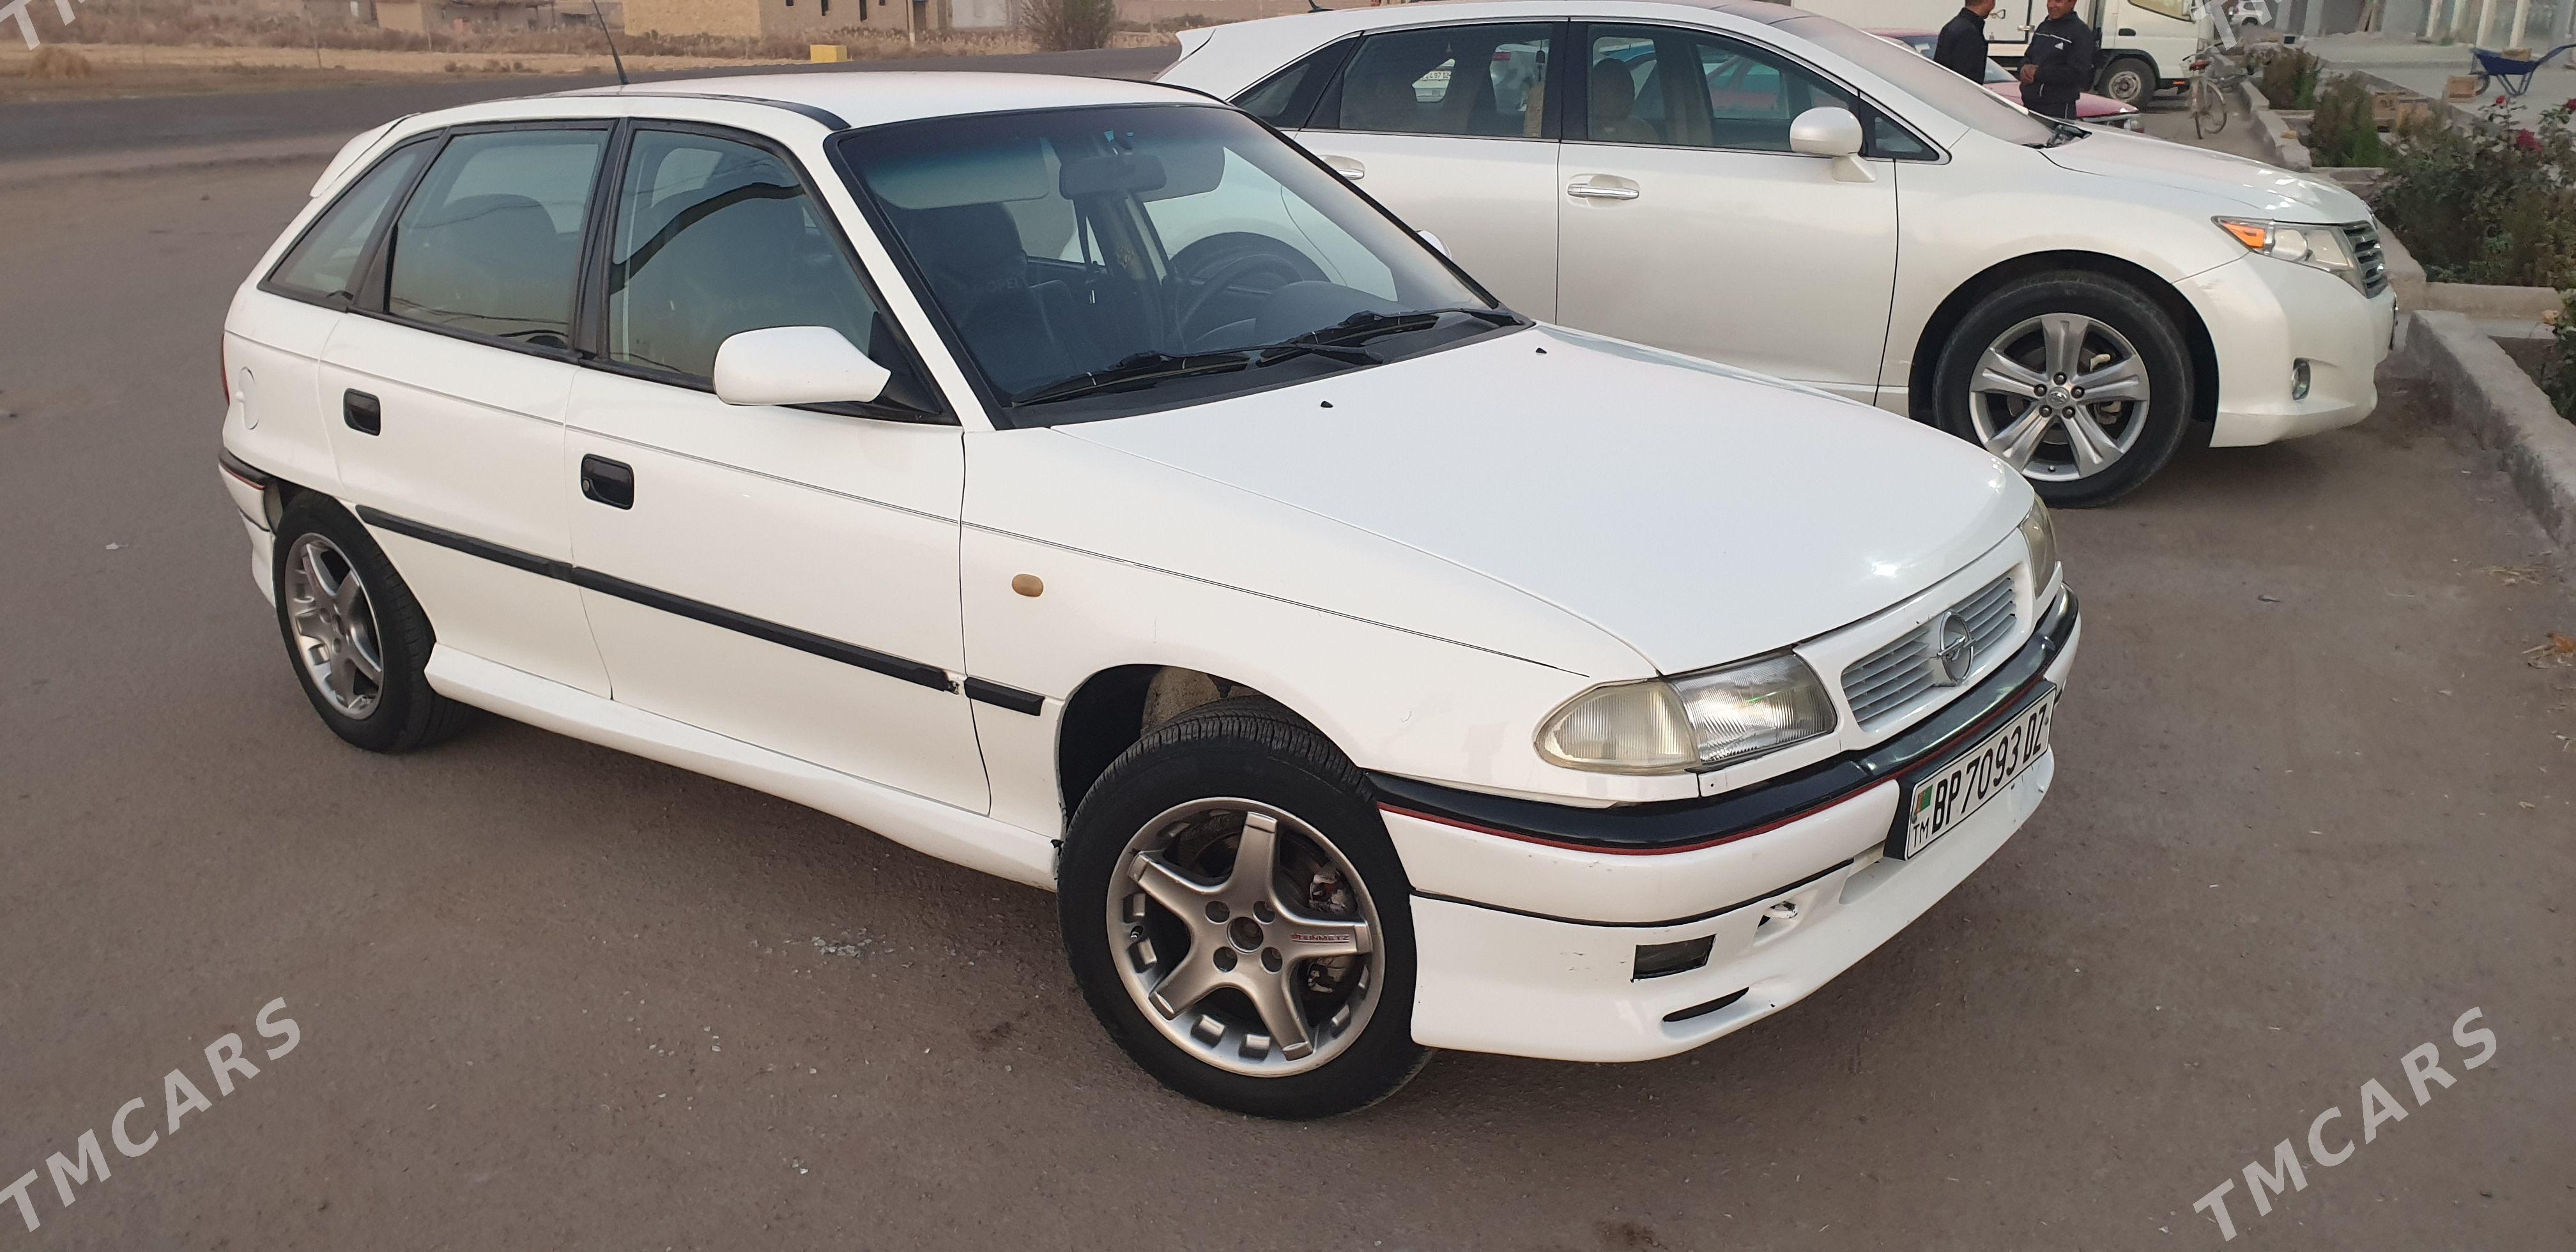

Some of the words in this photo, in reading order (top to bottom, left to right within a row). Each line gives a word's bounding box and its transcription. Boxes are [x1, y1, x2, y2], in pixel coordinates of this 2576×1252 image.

[1932, 770, 1961, 835] BP
[1961, 725, 2021, 814] 7093
[2023, 703, 2047, 764] DZ
[1913, 817, 1929, 848] TM
[1291, 933, 1349, 941] STEINMETZ
